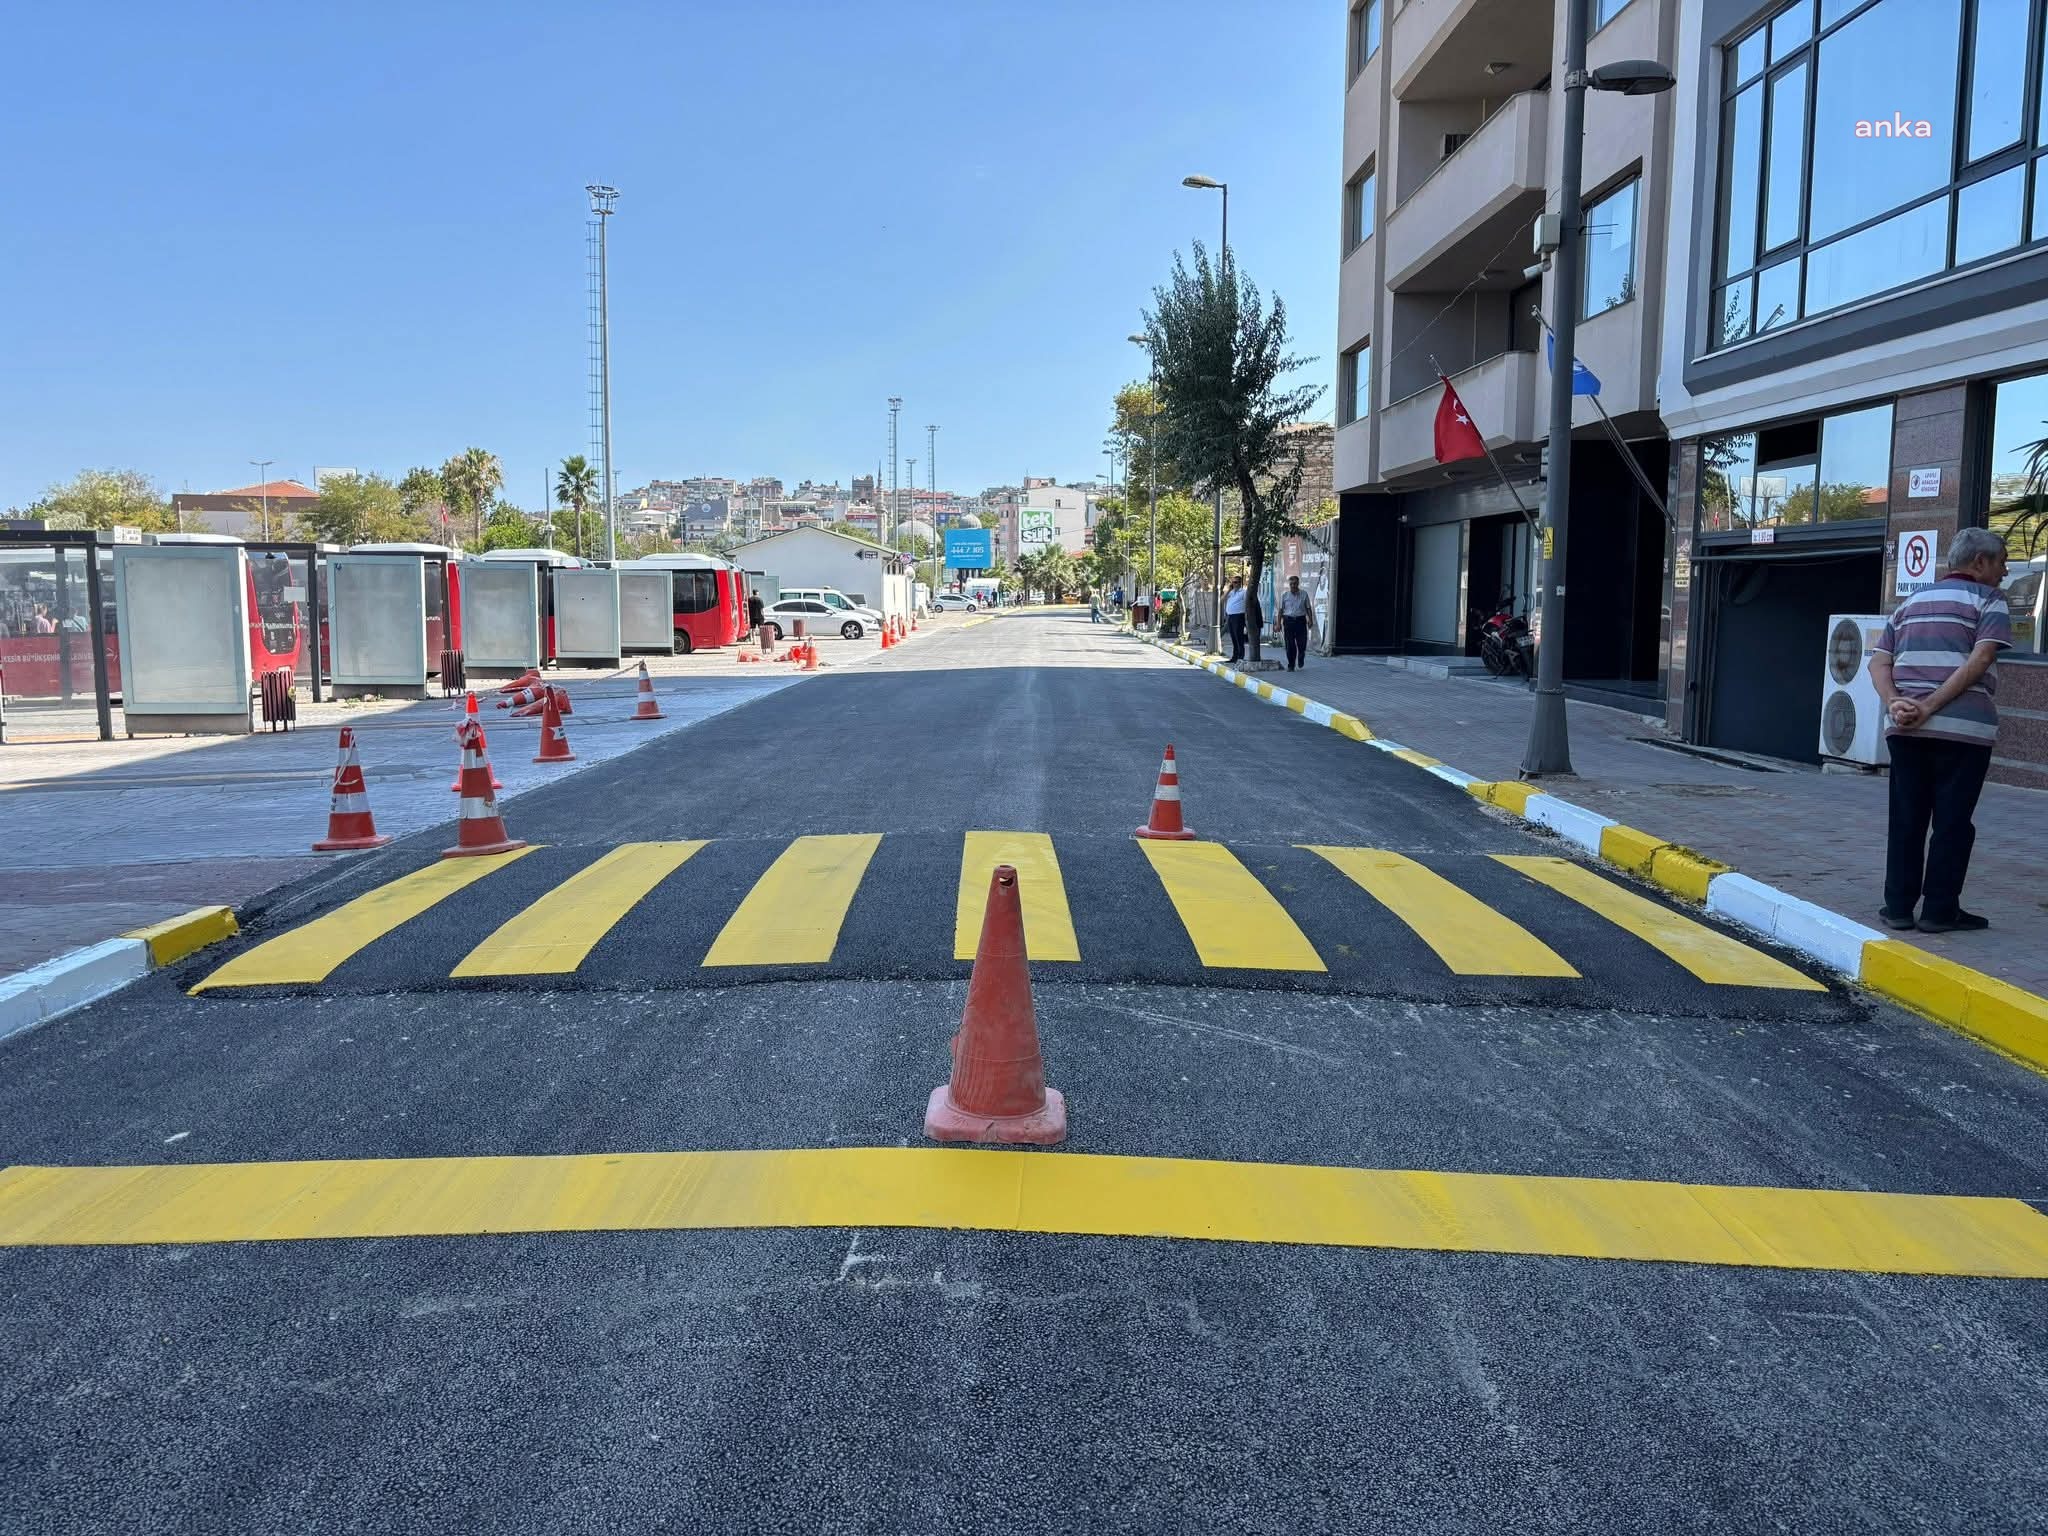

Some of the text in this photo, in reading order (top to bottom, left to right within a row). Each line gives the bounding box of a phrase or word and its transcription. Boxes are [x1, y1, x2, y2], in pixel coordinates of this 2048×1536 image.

[1022, 511, 1051, 529] tek
[1022, 527, 1051, 543] süt
[1897, 582, 1909, 593] PARK
